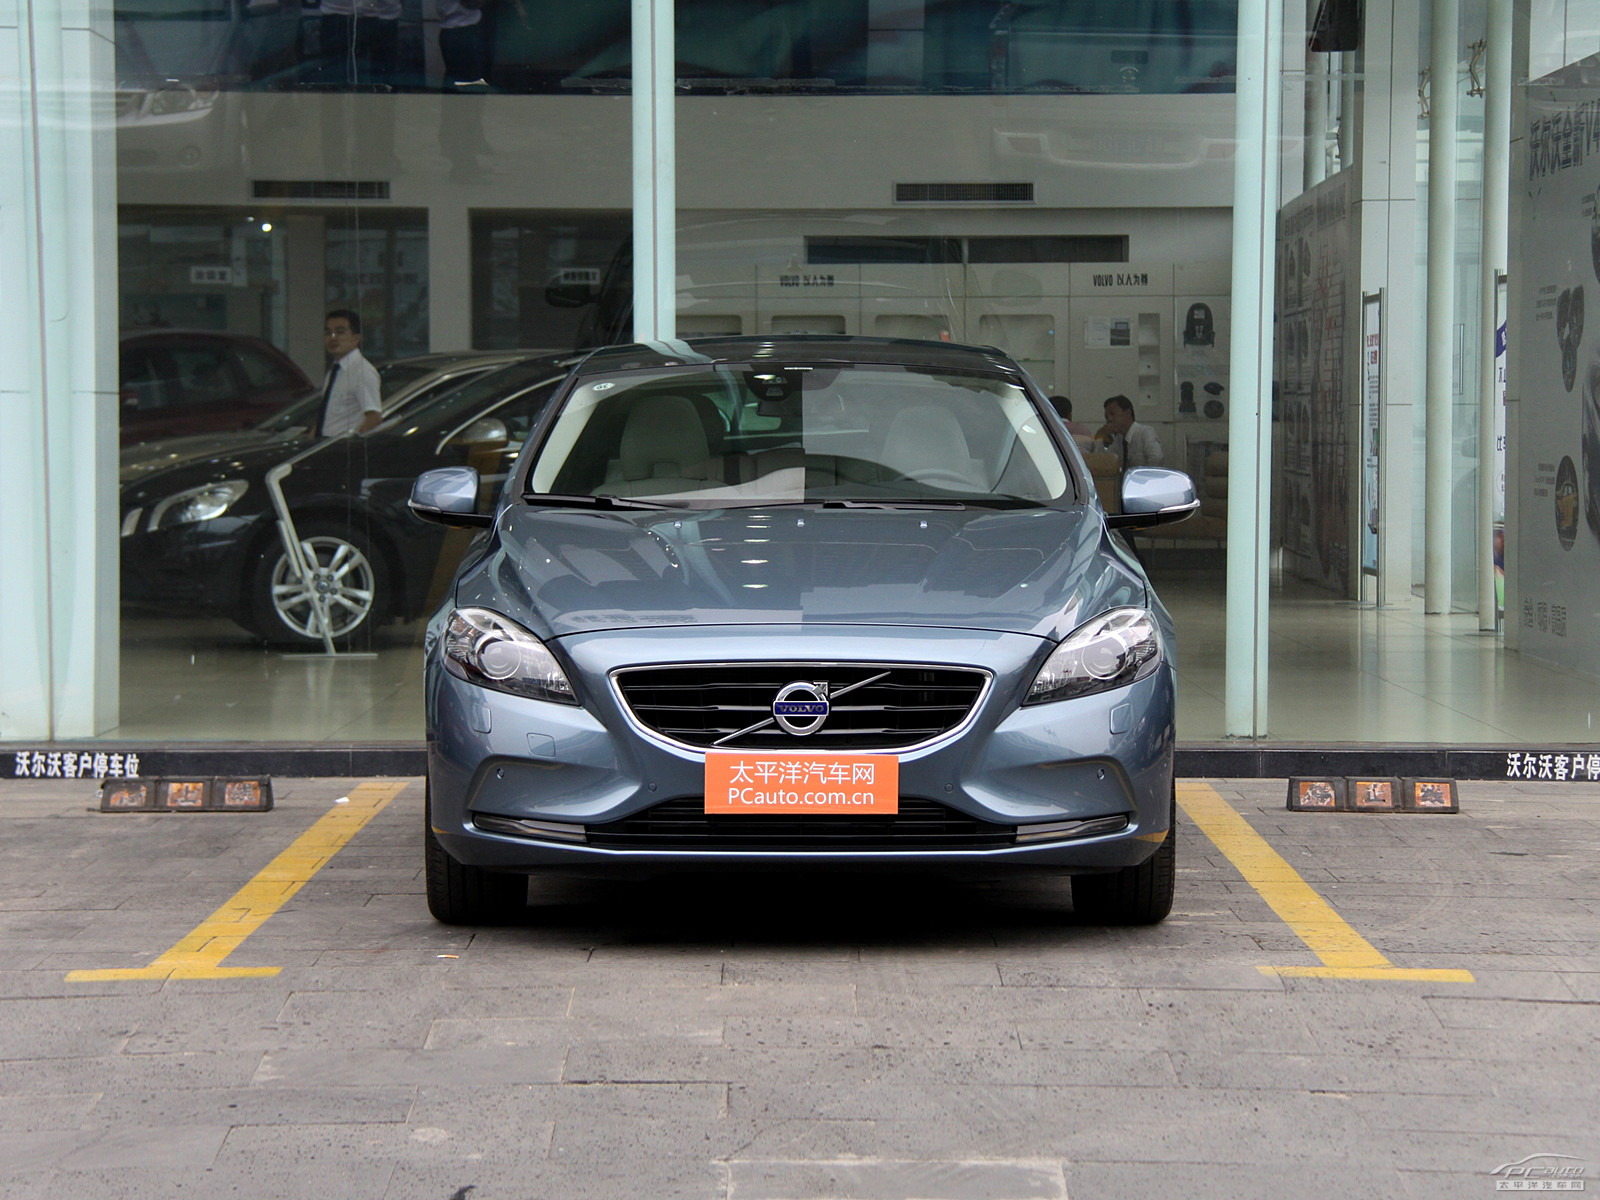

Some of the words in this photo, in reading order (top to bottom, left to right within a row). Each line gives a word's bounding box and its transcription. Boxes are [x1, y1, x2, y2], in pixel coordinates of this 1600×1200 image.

[1092, 274, 1114, 287] VOLVO
[777, 704, 825, 713] VOLVO
[14, 751, 140, 778] 沃尔沃客户停车位
[729, 761, 875, 785] 太平洋汽车网
[1506, 752, 1600, 780] 沃尔沃客户停
[728, 788, 875, 805] PCauto.com.cn
